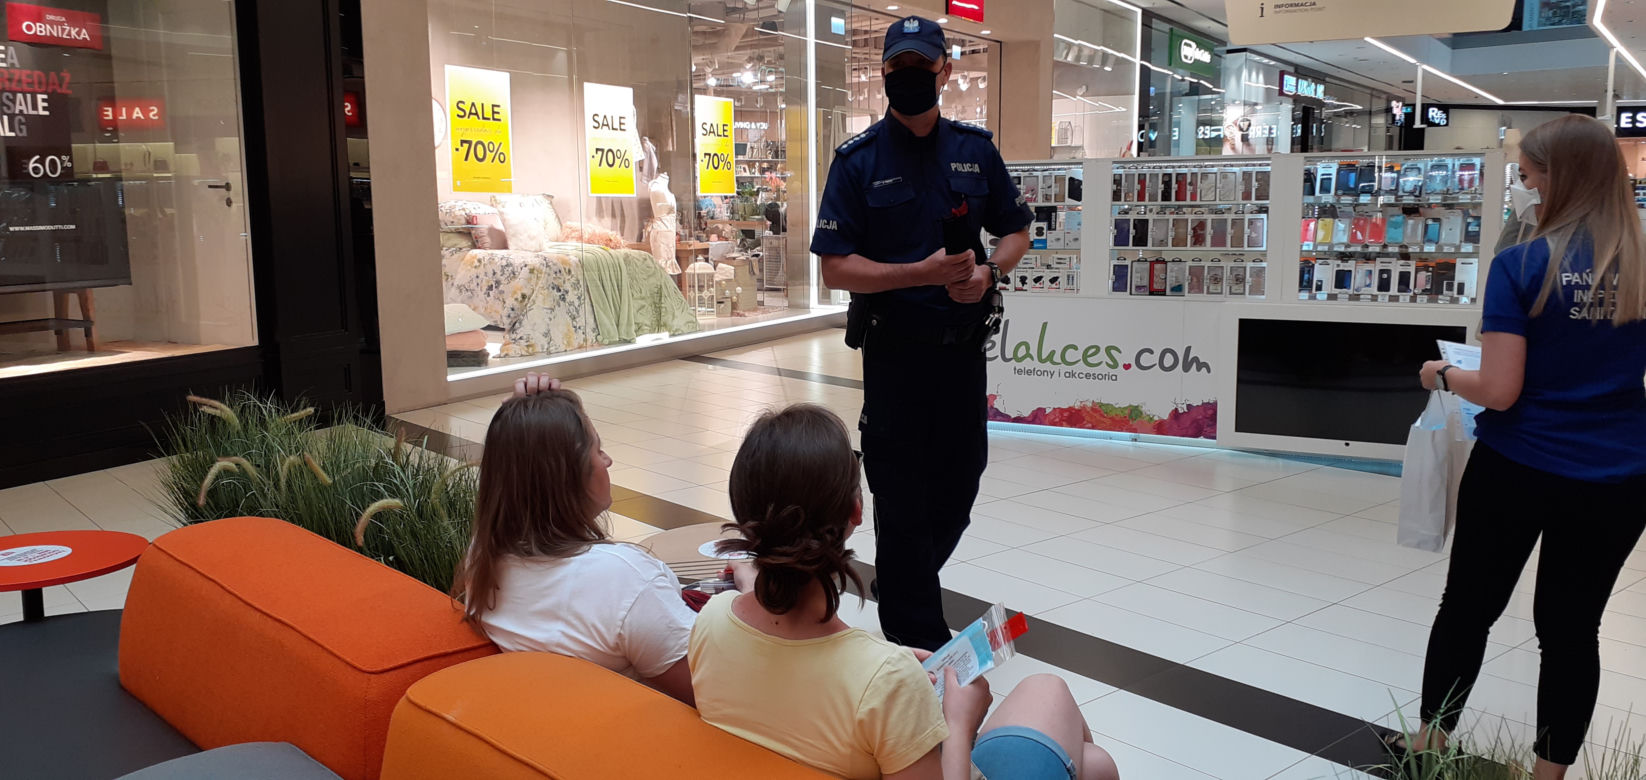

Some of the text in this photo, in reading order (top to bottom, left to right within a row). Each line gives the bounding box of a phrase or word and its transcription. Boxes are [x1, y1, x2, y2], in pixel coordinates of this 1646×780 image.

[1273, 1, 1317, 9] INFORMACJA
[22, 21, 91, 41] OBNIŻKA
[0, 45, 20, 68] EA
[0, 68, 73, 94] RZEDAŻ
[2, 92, 50, 115] SALE
[456, 100, 502, 122] SALE
[592, 113, 627, 132] SALE
[701, 122, 729, 138] SALE
[455, 139, 506, 164] -70%
[592, 148, 630, 169] -70%
[701, 152, 732, 171] -70%
[950, 162, 980, 174] POLICJA
[816, 219, 838, 230] LICJA
[984, 319, 1211, 375] elakces.com
[1013, 366, 1118, 381] telefony i akcesoria
